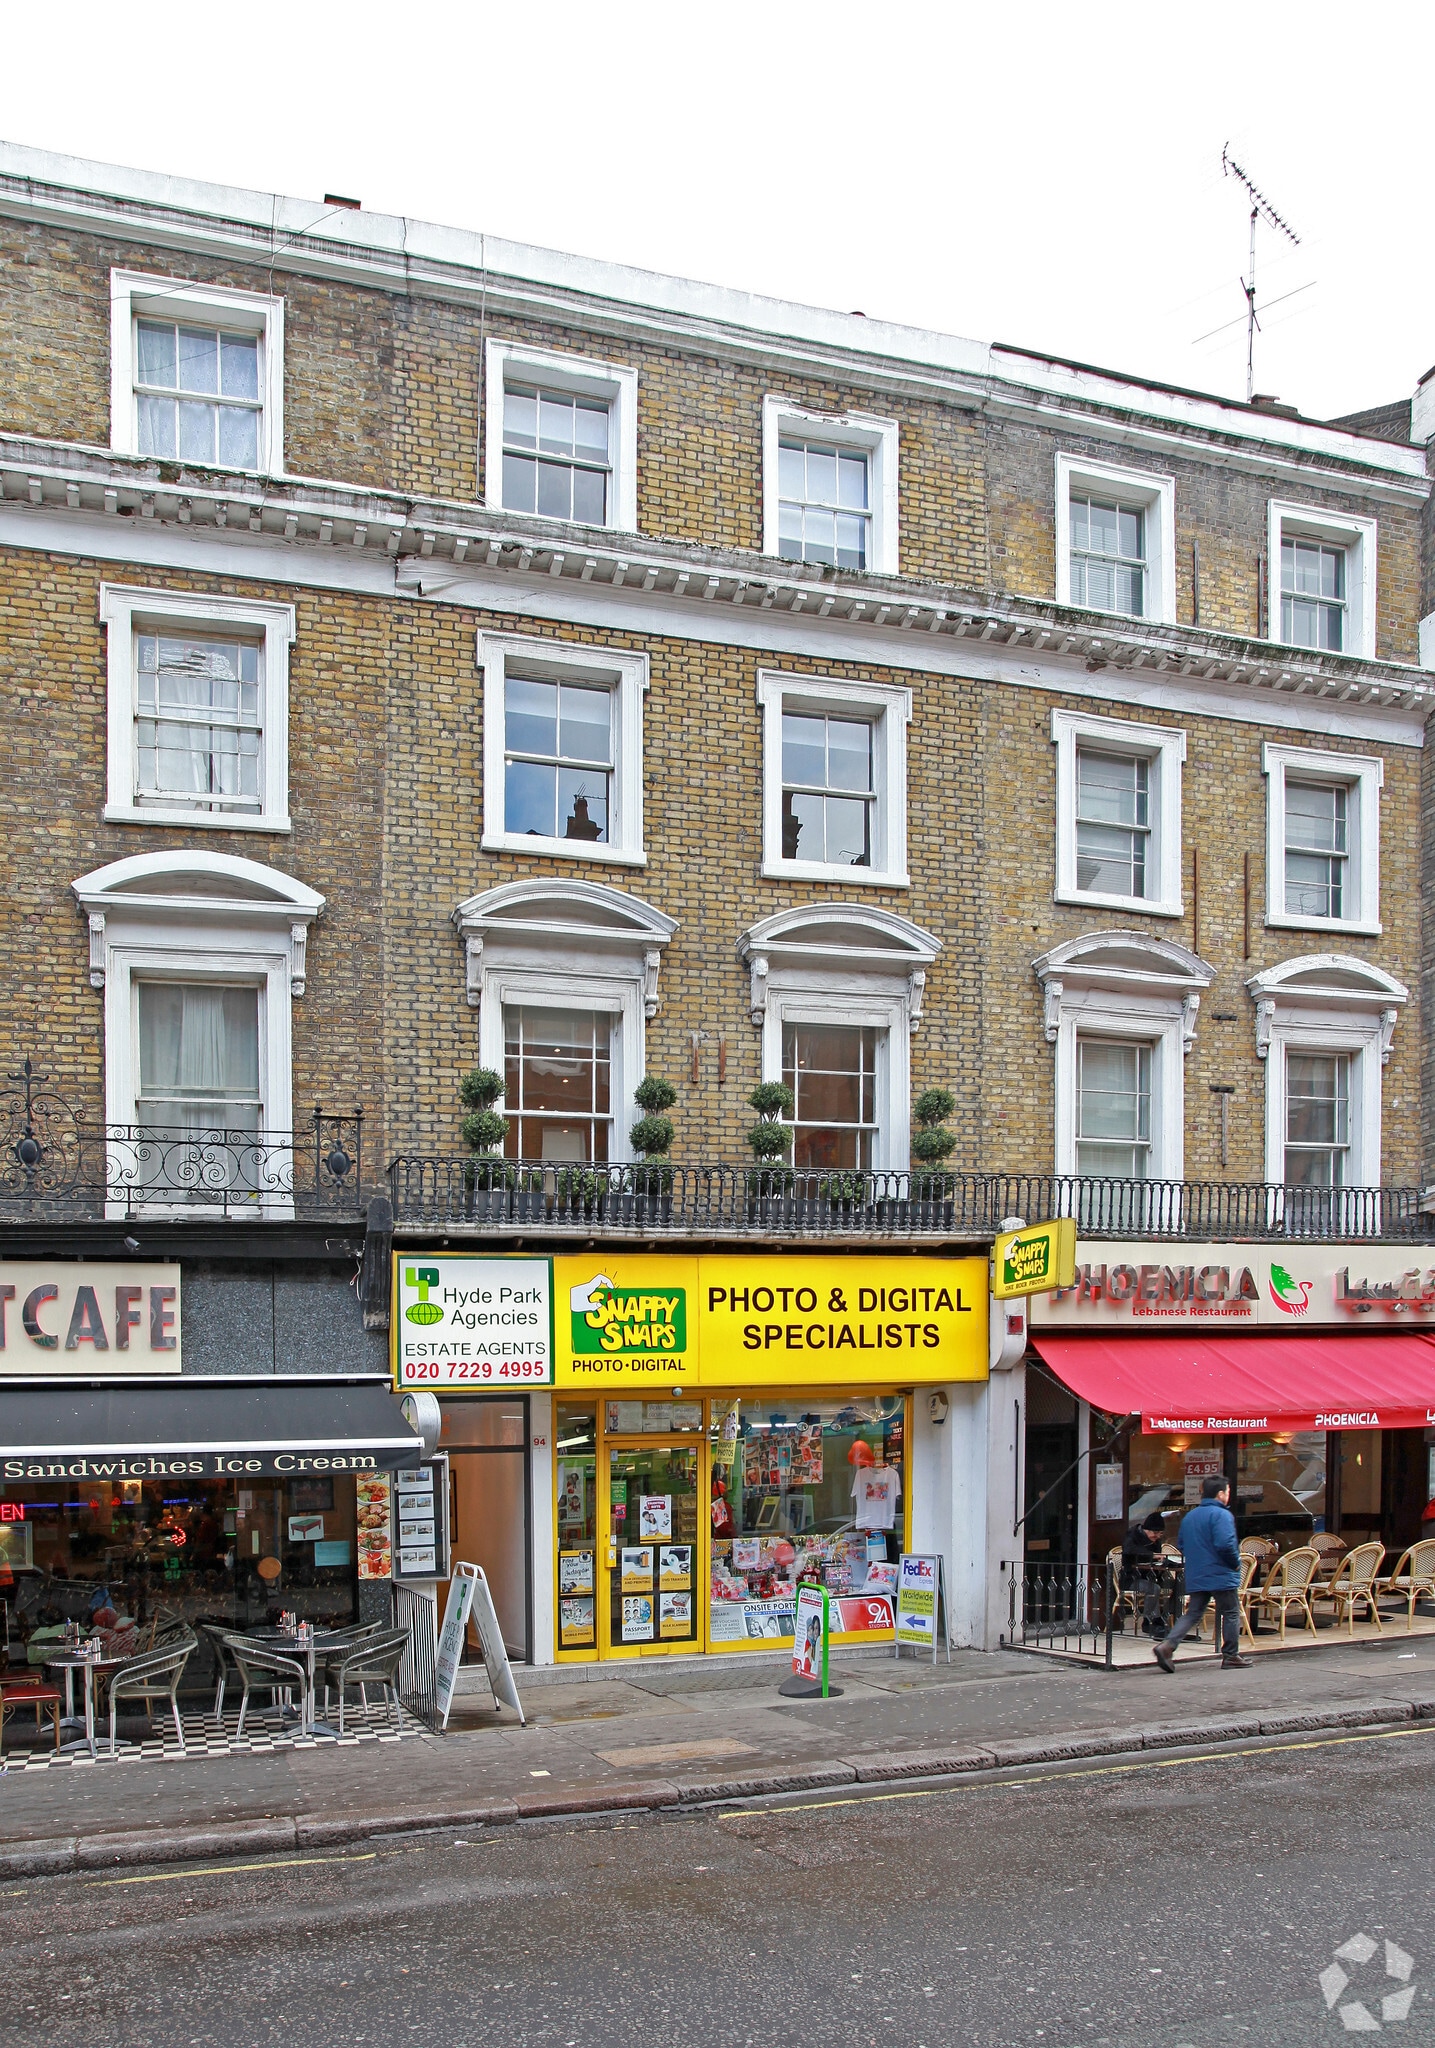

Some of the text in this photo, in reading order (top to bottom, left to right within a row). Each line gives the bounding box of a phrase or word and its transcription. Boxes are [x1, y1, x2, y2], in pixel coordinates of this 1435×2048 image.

[1010, 1241, 1047, 1268] SNAPPY
[1014, 1258, 1045, 1280] SNAPS
[444, 1287, 543, 1308] Hyde Park
[708, 1287, 972, 1312] PHOTO & DIGITAL
[585, 1291, 680, 1328] SNAPPY
[1132, 1307, 1252, 1316] Lebanese Restaurant
[451, 1309, 539, 1330] Agencies
[600, 1322, 676, 1352] SNAPS
[743, 1324, 940, 1349] SPECIALISTS
[405, 1342, 546, 1357] ESTATE AGENTS
[405, 1361, 544, 1379] 020 7229 4995
[1150, 1416, 1268, 1429] Lebanese Restaurant
[1314, 1412, 1380, 1426] PHOENICIA
[533, 1437, 546, 1446] 94
[718, 1449, 734, 1457] PHOTOS
[4, 1454, 378, 1478] Sandwiches Ice Cream
[1187, 1463, 1218, 1474] £4.95
[1, 1503, 24, 1520] EN
[903, 1559, 932, 1577] FedEx
[903, 1590, 933, 1602] Worldwide
[743, 1603, 771, 1611] ONSITE
[868, 1602, 891, 1627] 94
